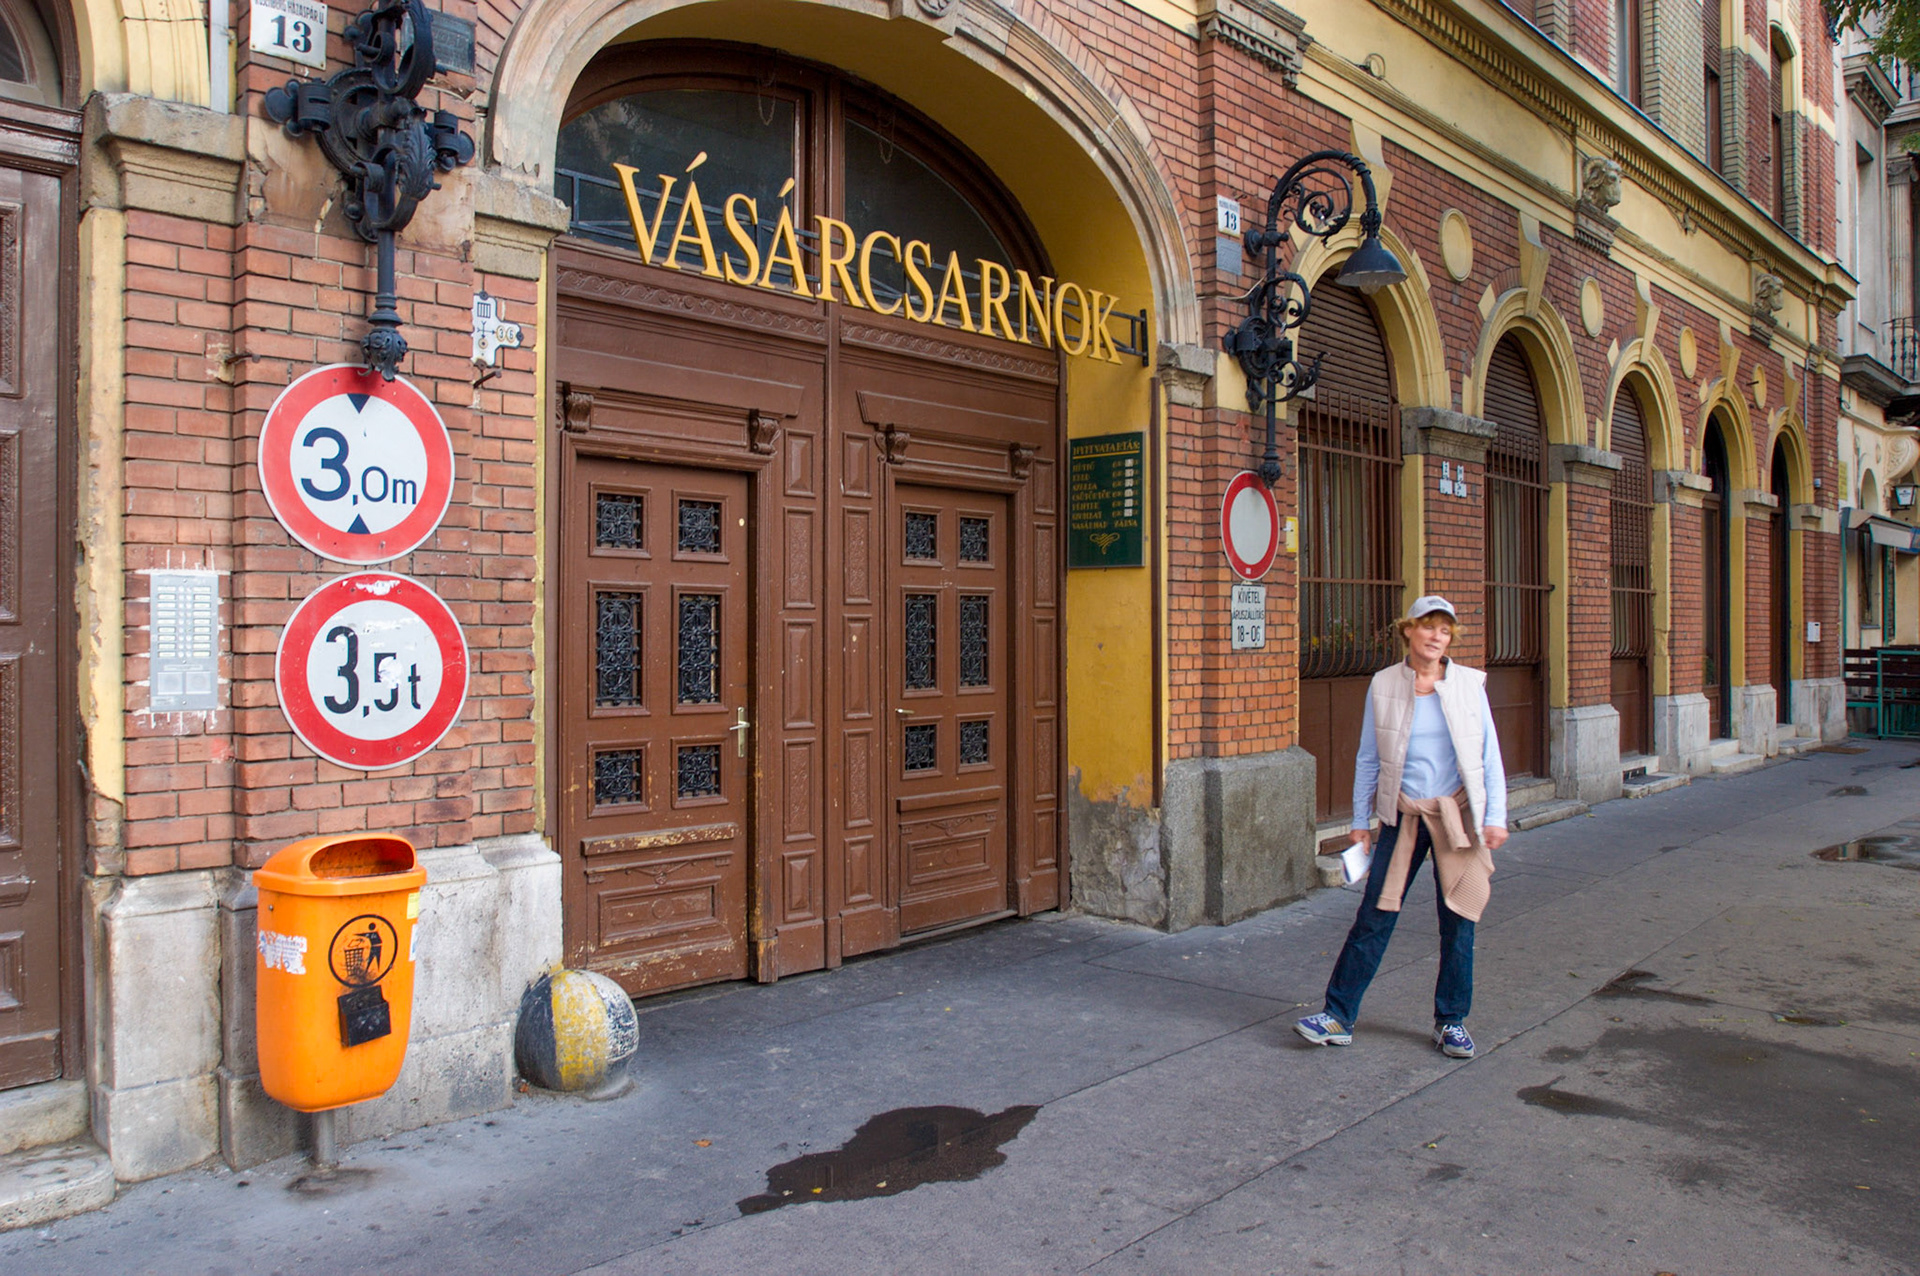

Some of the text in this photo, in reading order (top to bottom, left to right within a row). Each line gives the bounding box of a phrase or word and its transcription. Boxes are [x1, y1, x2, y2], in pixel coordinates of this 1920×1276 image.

[270, 14, 312, 53] 13
[1224, 210, 1237, 231] 13
[611, 151, 1123, 365] VÁSÁRCSARNOK
[1237, 588, 1261, 604] KIVÉTEL
